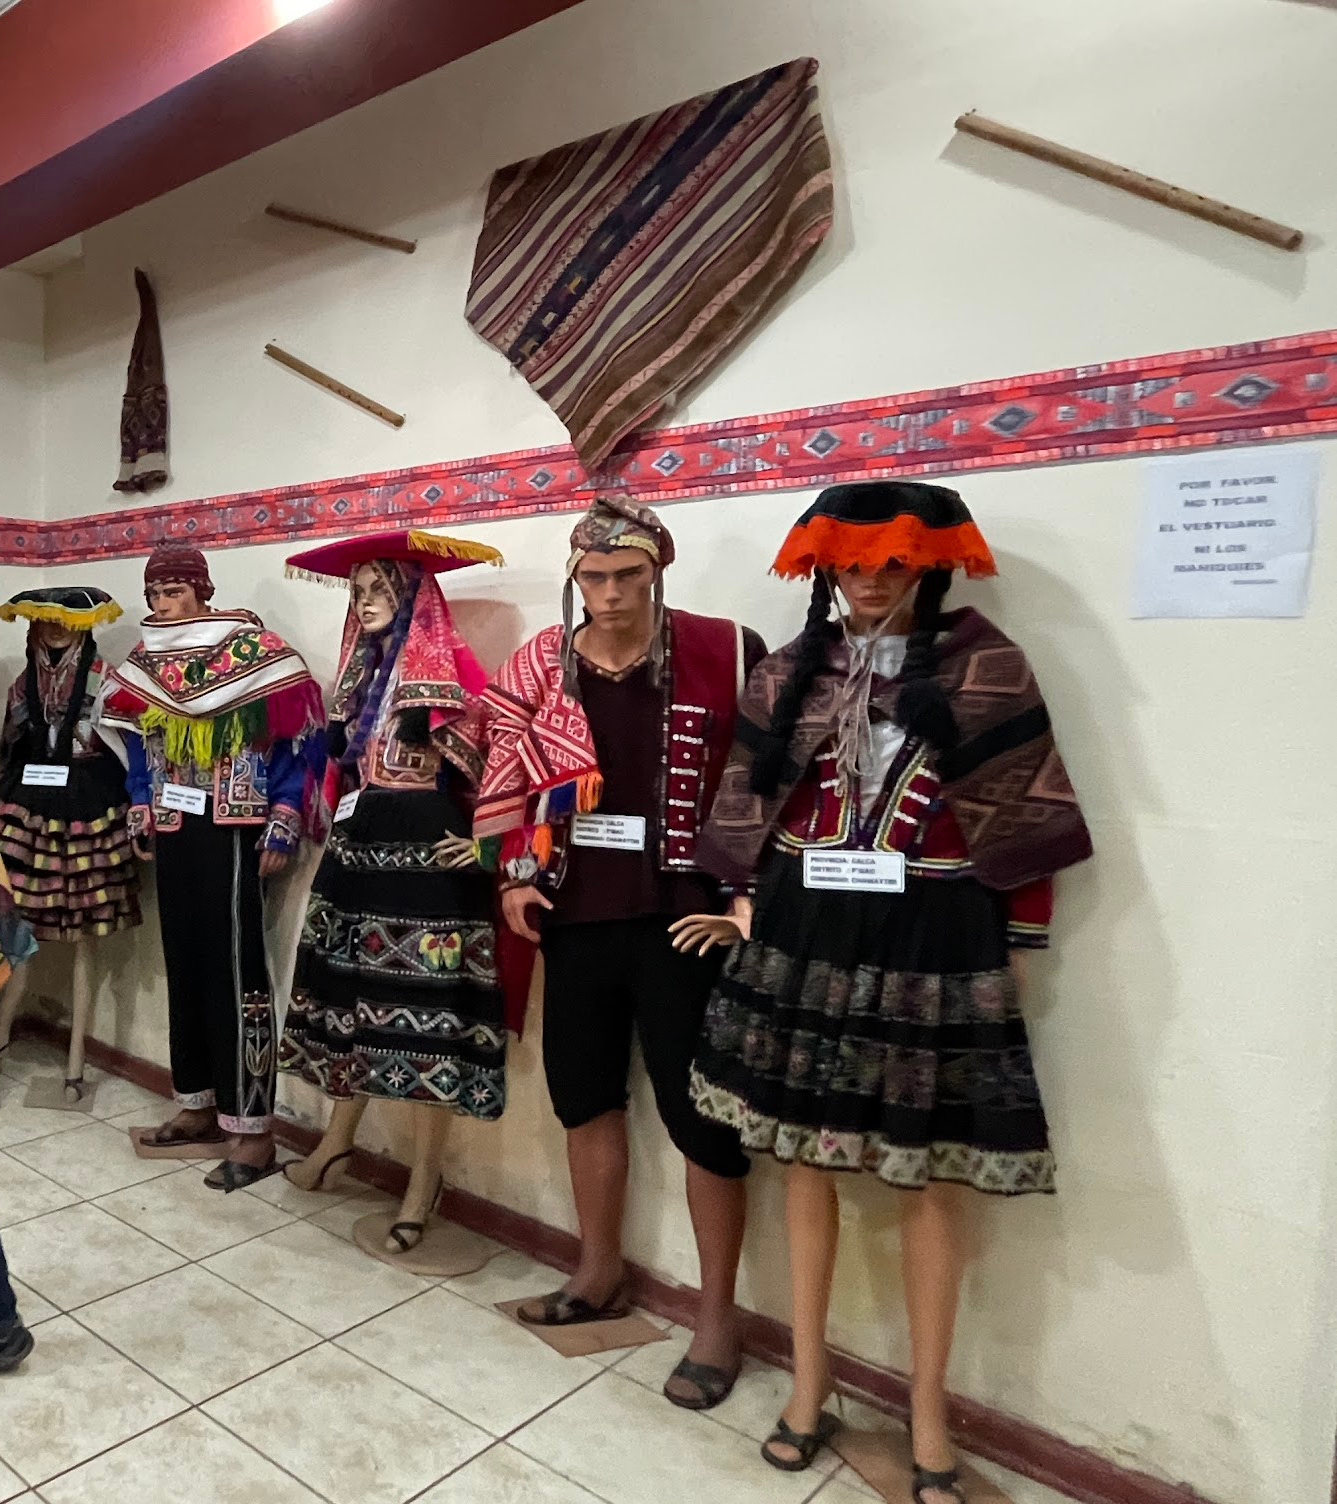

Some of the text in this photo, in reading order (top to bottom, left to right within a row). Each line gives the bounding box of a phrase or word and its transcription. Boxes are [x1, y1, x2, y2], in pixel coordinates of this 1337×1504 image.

[1179, 481, 1211, 490] POR
[1184, 495, 1268, 507] NO TOCAR
[1159, 519, 1276, 532] EL VESTUARIO
[1215, 544, 1246, 553] LOS
